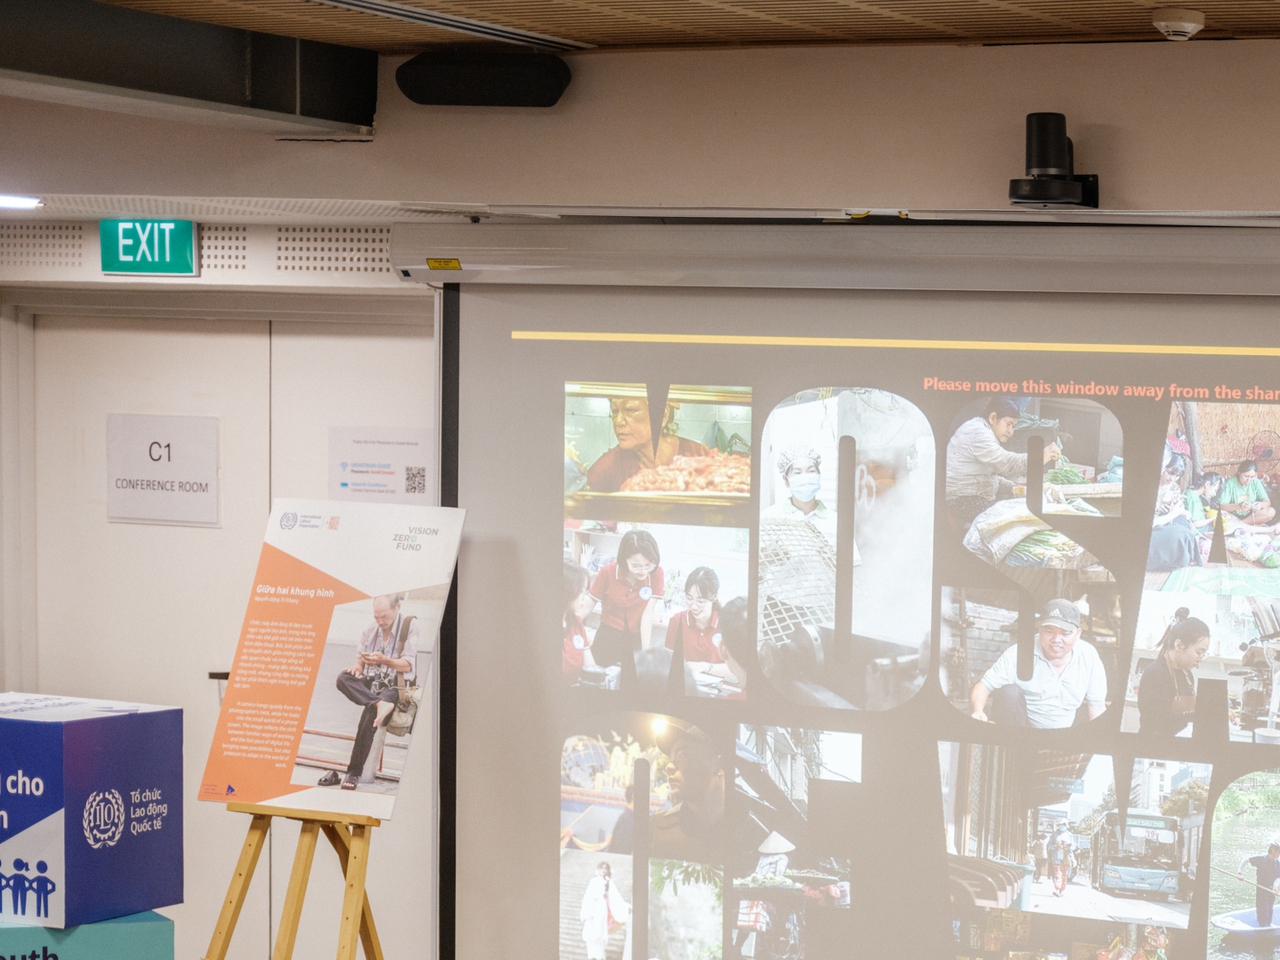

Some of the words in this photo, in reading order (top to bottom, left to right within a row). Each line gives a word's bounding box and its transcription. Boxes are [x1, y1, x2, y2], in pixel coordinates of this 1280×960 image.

[118, 222, 175, 262] EXIT
[923, 377, 971, 391] Please
[975, 381, 1018, 393] move
[1022, 379, 1052, 393] this
[1056, 381, 1119, 396] window
[1123, 385, 1165, 401] away
[1169, 383, 1209, 398] from
[1214, 385, 1241, 399] the
[149, 441, 171, 462] C1
[115, 478, 175, 492] CONFERENCE
[178, 481, 208, 493] ROOM
[393, 534, 417, 543] ZERO
[408, 526, 439, 536] VISION
[396, 542, 421, 551] FUND
[256, 584, 276, 594] Giữa
[276, 586, 289, 595] hai
[290, 586, 315, 598] khung
[316, 587, 335, 598] hình
[6, 769, 44, 796] cho
[130, 789, 140, 804] Tổ
[141, 787, 162, 801] chức
[95, 802, 114, 829] ILO
[130, 806, 146, 819] Lao
[146, 803, 168, 817] động
[130, 818, 152, 836] Quốc
[153, 816, 162, 830] tế
